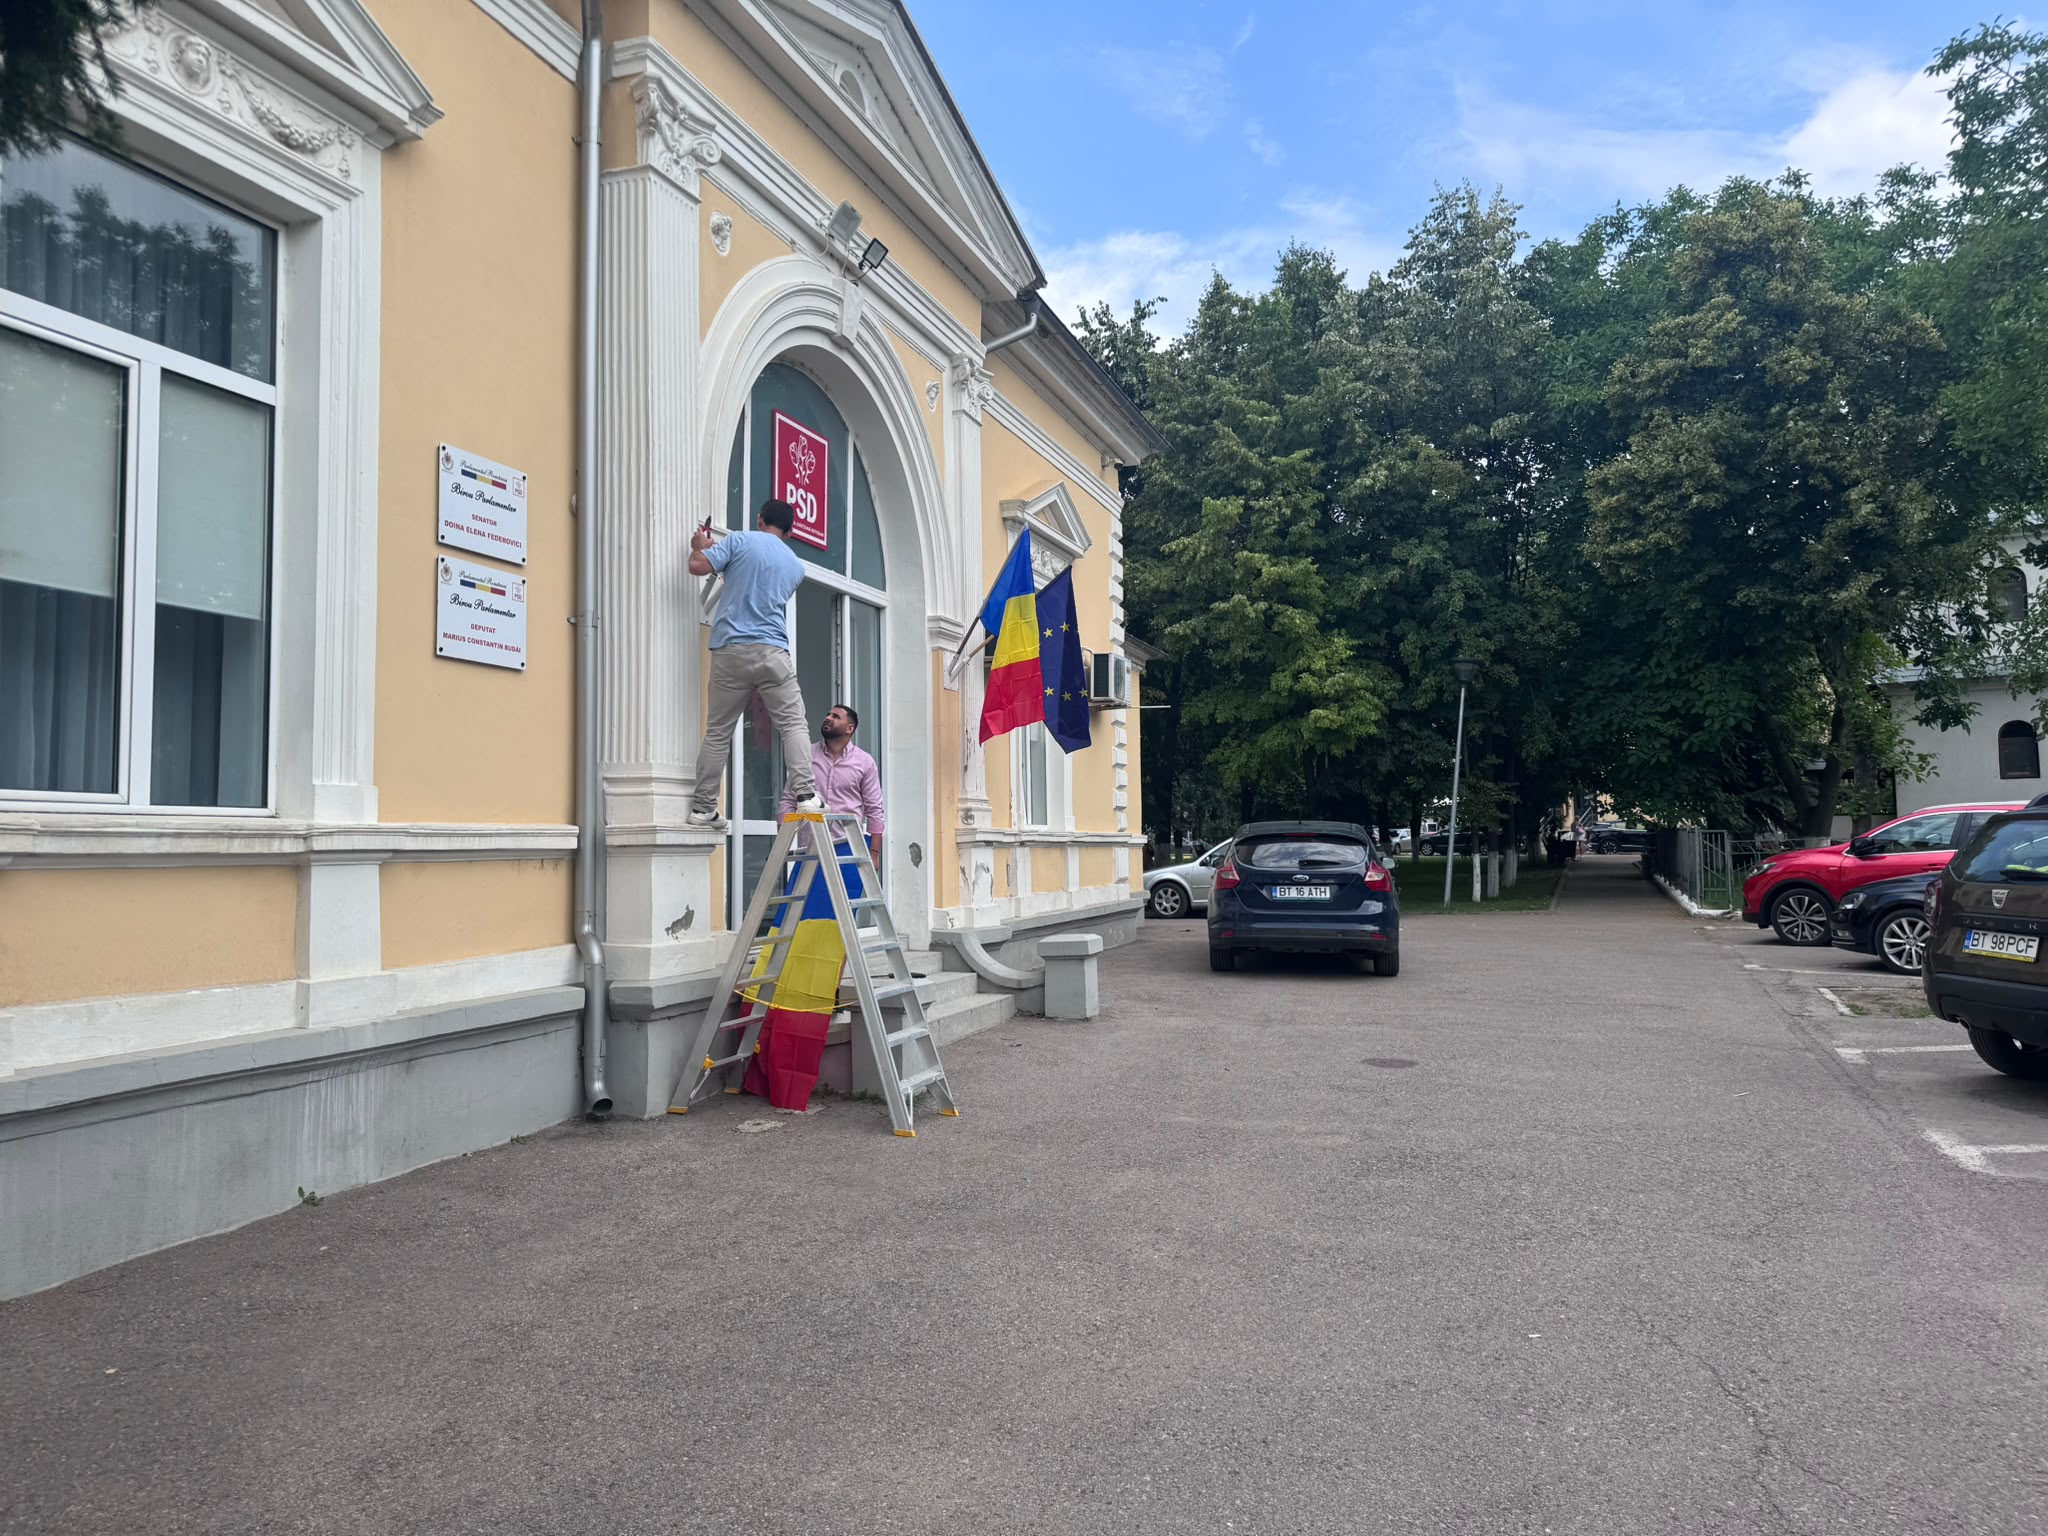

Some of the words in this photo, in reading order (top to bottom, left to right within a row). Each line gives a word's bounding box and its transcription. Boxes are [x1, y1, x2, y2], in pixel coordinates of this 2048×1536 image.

[451, 482, 473, 498] Birou
[475, 490, 516, 512] Parlamentar
[786, 481, 817, 523] PSD
[472, 514, 497, 526] SENATOR
[444, 520, 465, 532] DOINA
[466, 526, 486, 538] ELENA
[487, 532, 522, 549] FEDEROVICI
[450, 593, 472, 608] Birou
[474, 599, 516, 618] Parlamentar
[470, 623, 496, 634] DEPUTAT
[442, 632, 466, 643] MARIUS
[467, 637, 504, 650] CONSTANTIN
[1279, 887, 1292, 897] BT
[1295, 887, 1305, 897] 16
[1308, 887, 1327, 897] ATH
[1971, 931, 1988, 948] BT
